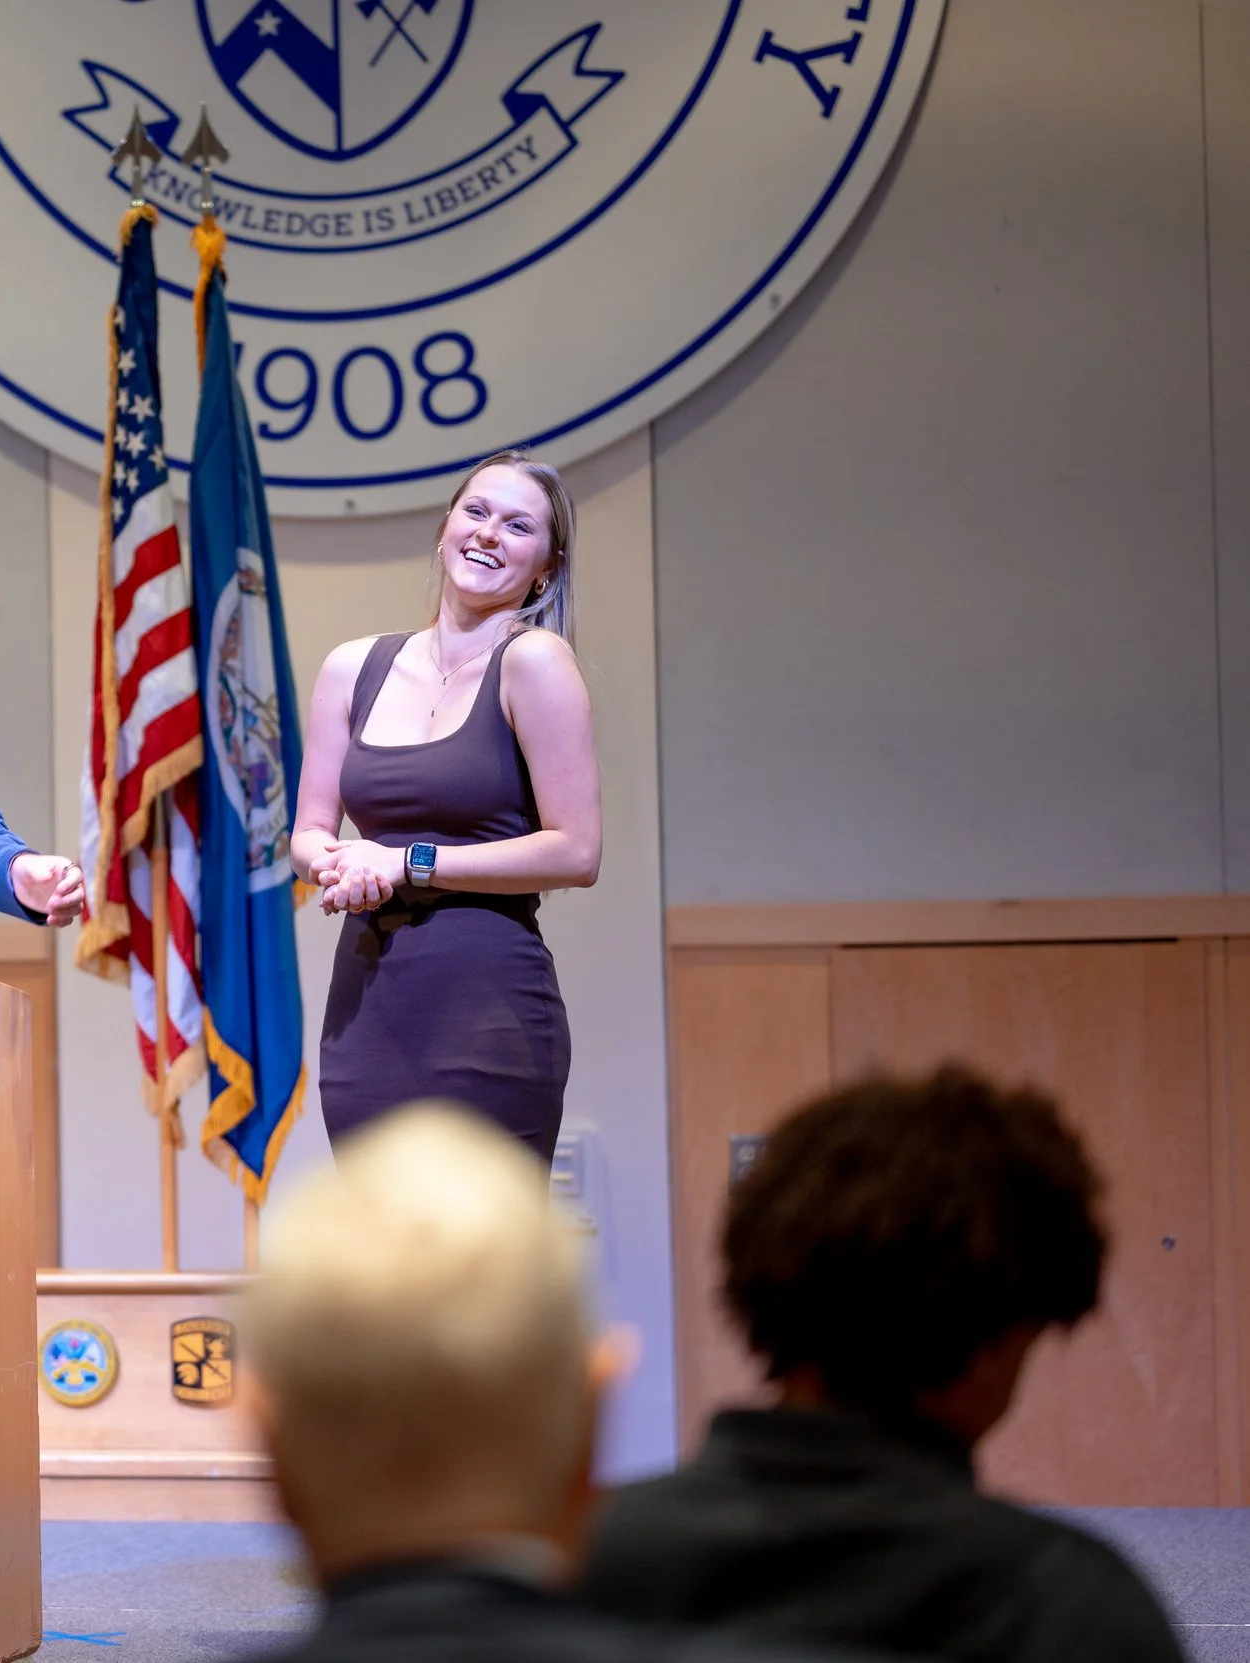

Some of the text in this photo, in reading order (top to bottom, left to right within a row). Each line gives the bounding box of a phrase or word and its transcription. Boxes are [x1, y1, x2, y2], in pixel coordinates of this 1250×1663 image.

[363, 206, 396, 235] IS
[403, 134, 539, 226] LIBERTY
[233, 329, 489, 441] 908
